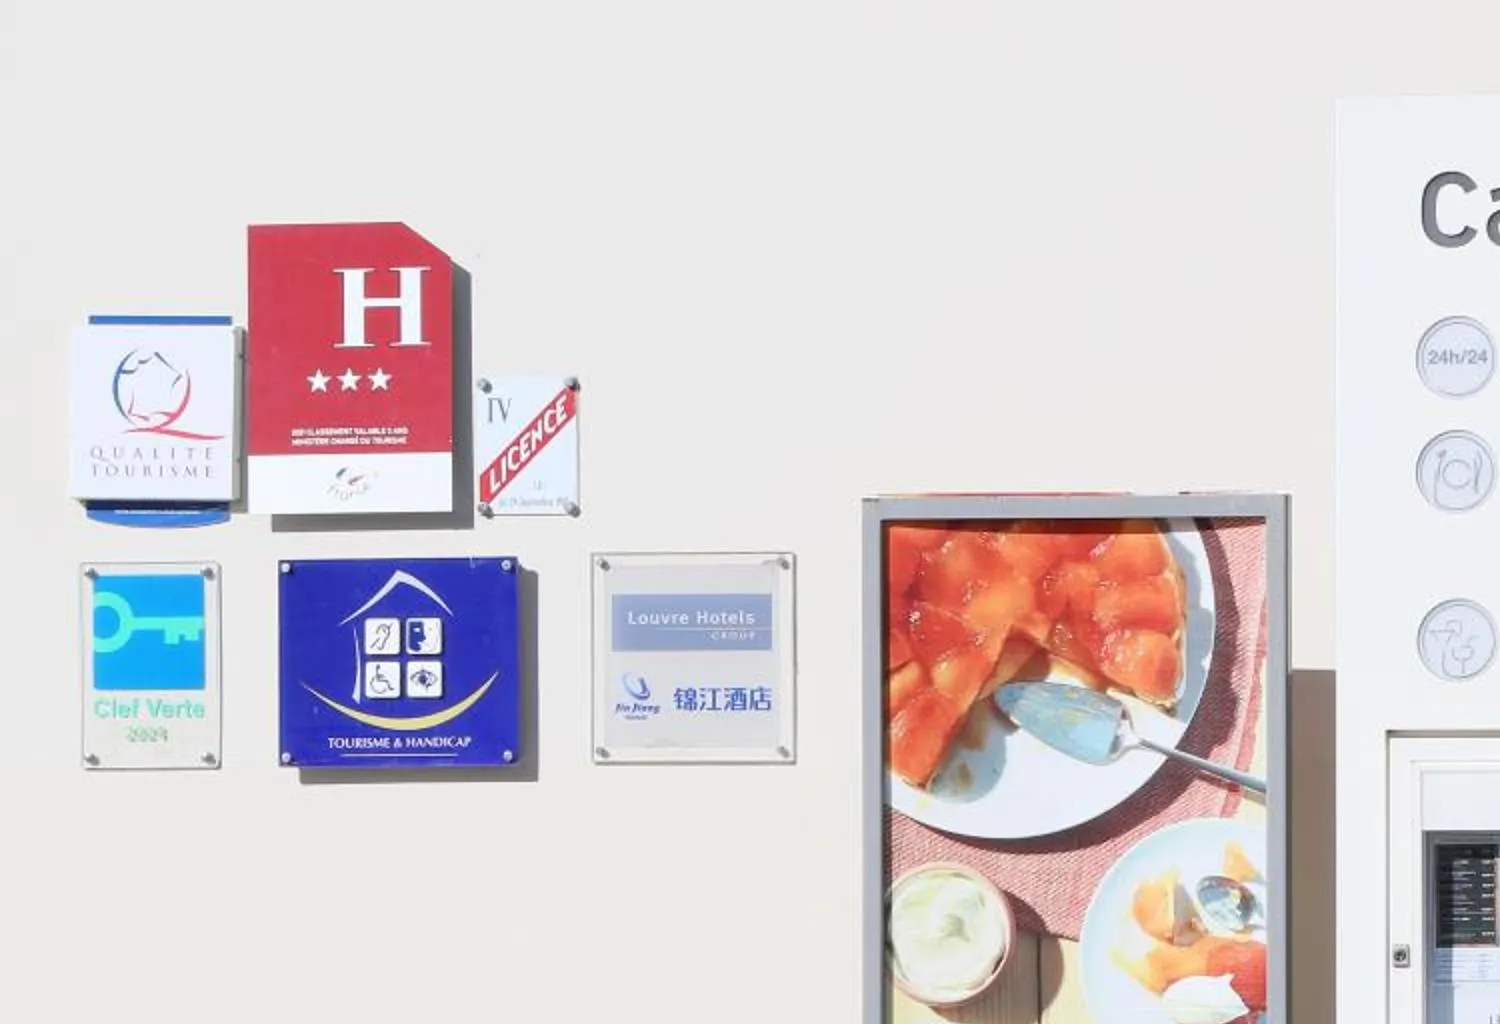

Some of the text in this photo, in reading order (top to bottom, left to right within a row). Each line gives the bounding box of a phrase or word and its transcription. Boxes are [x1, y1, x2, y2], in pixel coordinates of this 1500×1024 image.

[332, 265, 431, 347] H
[1427, 346, 1488, 366] 24h/24
[487, 397, 512, 423] IV
[489, 393, 567, 494] LICENCE
[91, 463, 215, 478] TOURISME
[627, 610, 756, 625] Louvre Hotels
[94, 697, 206, 719] Clef Verte
[672, 685, 773, 712] 锦江酒店
[328, 737, 391, 749] TOURISME
[405, 736, 472, 748] HANDICAP
